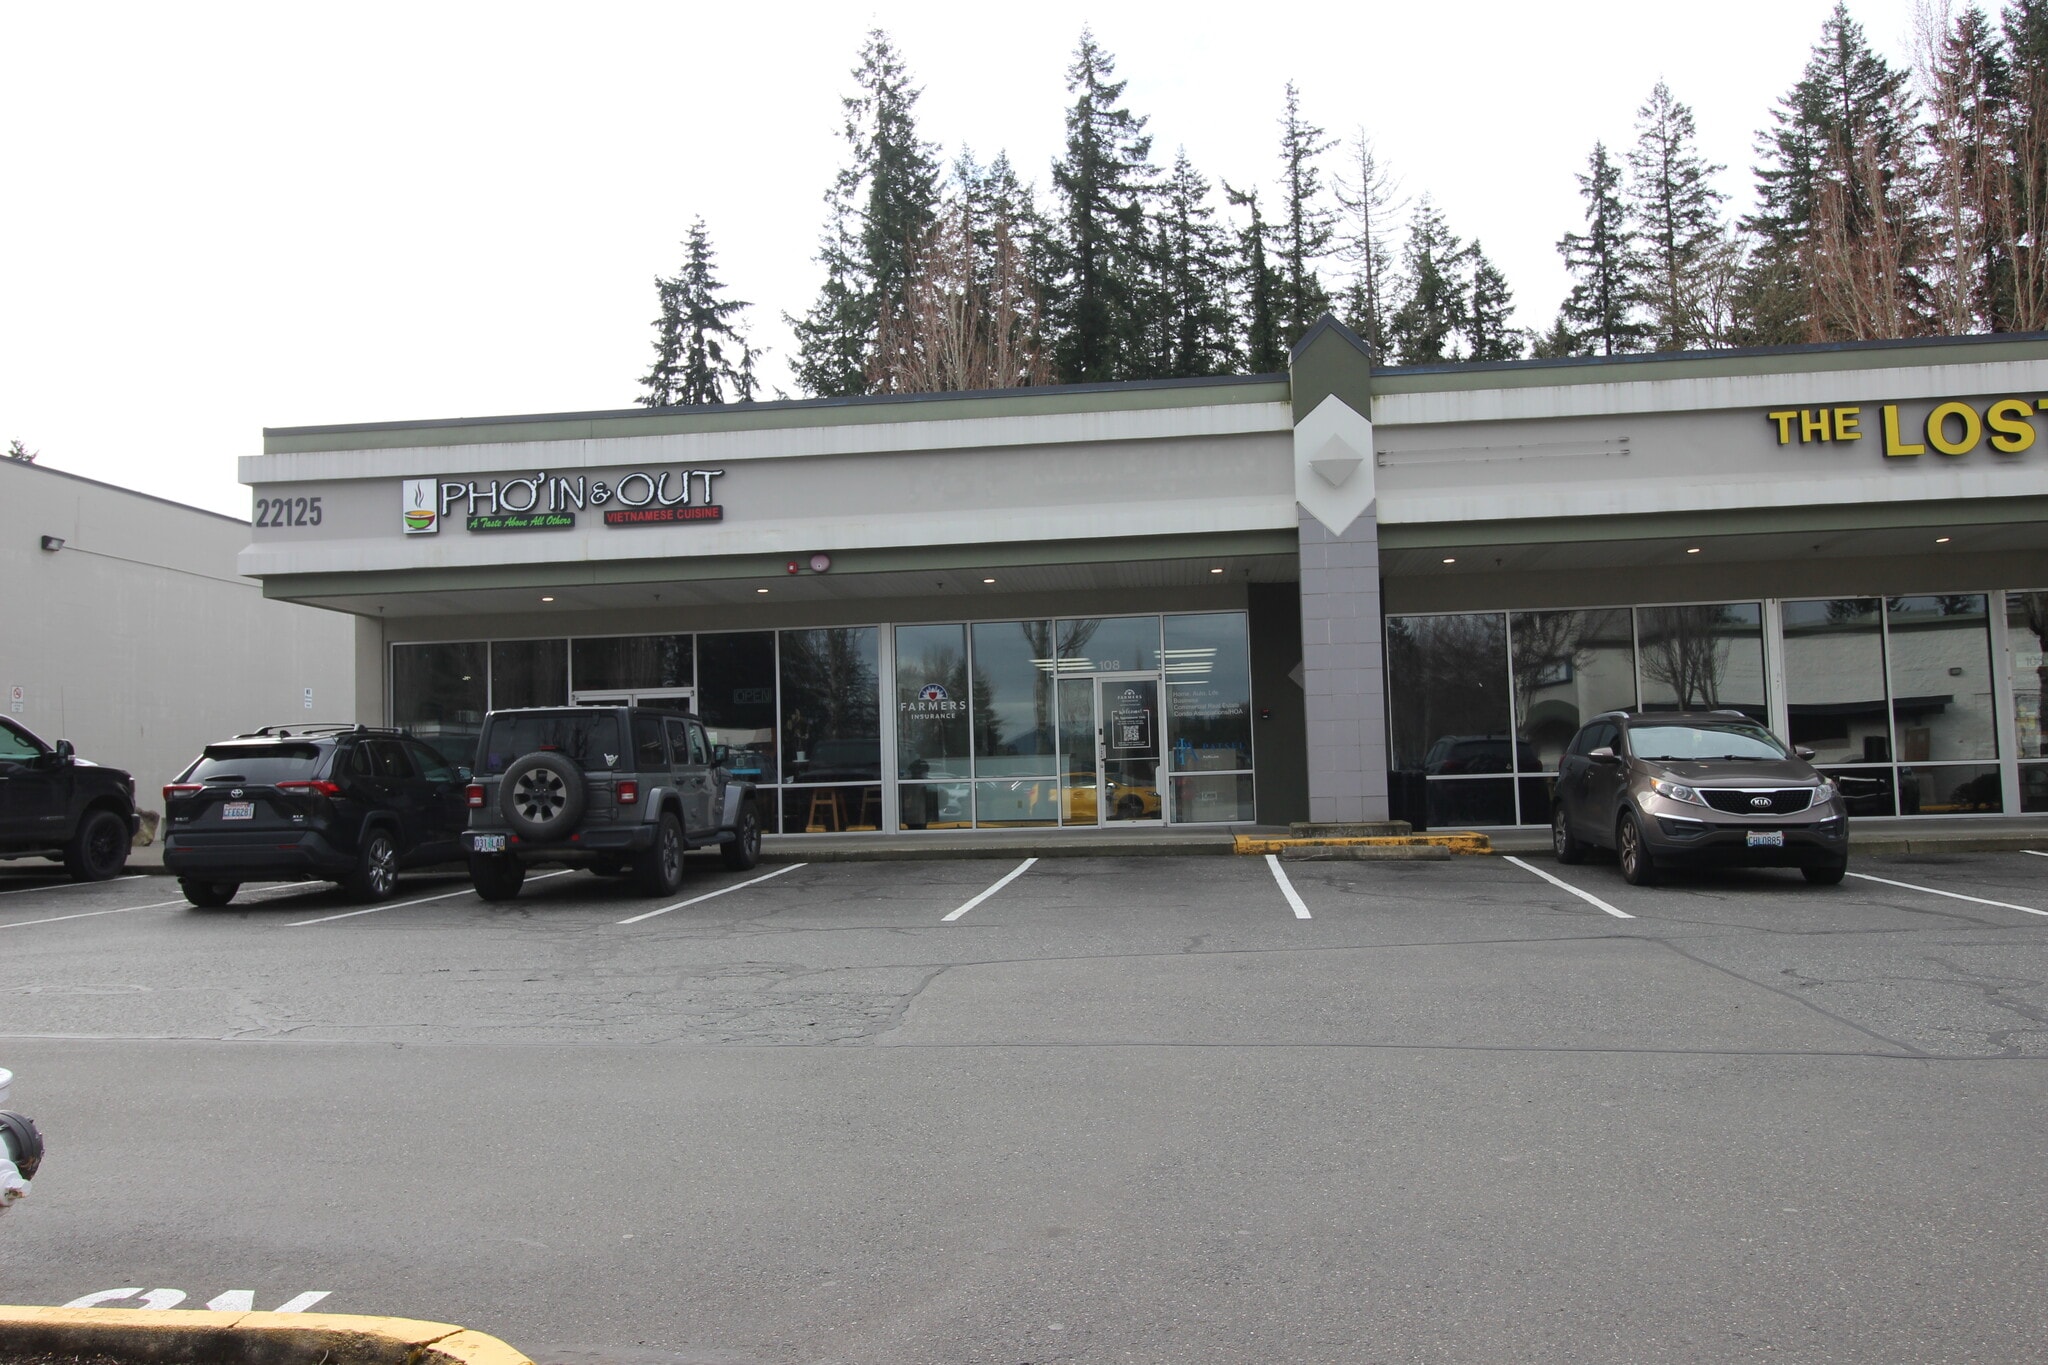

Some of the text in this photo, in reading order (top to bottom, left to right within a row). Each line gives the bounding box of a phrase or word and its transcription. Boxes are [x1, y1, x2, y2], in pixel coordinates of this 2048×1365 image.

[1768, 407, 1863, 445] THE
[590, 481, 614, 505] &
[616, 470, 724, 506] OUT
[256, 496, 323, 528] 22125
[607, 507, 720, 523] VIETNAMESE CUISINE
[469, 514, 571, 529] A Taste Above All Others
[1097, 660, 1120, 671] 108
[735, 688, 771, 703] OPEN
[900, 701, 966, 711] FARMERS
